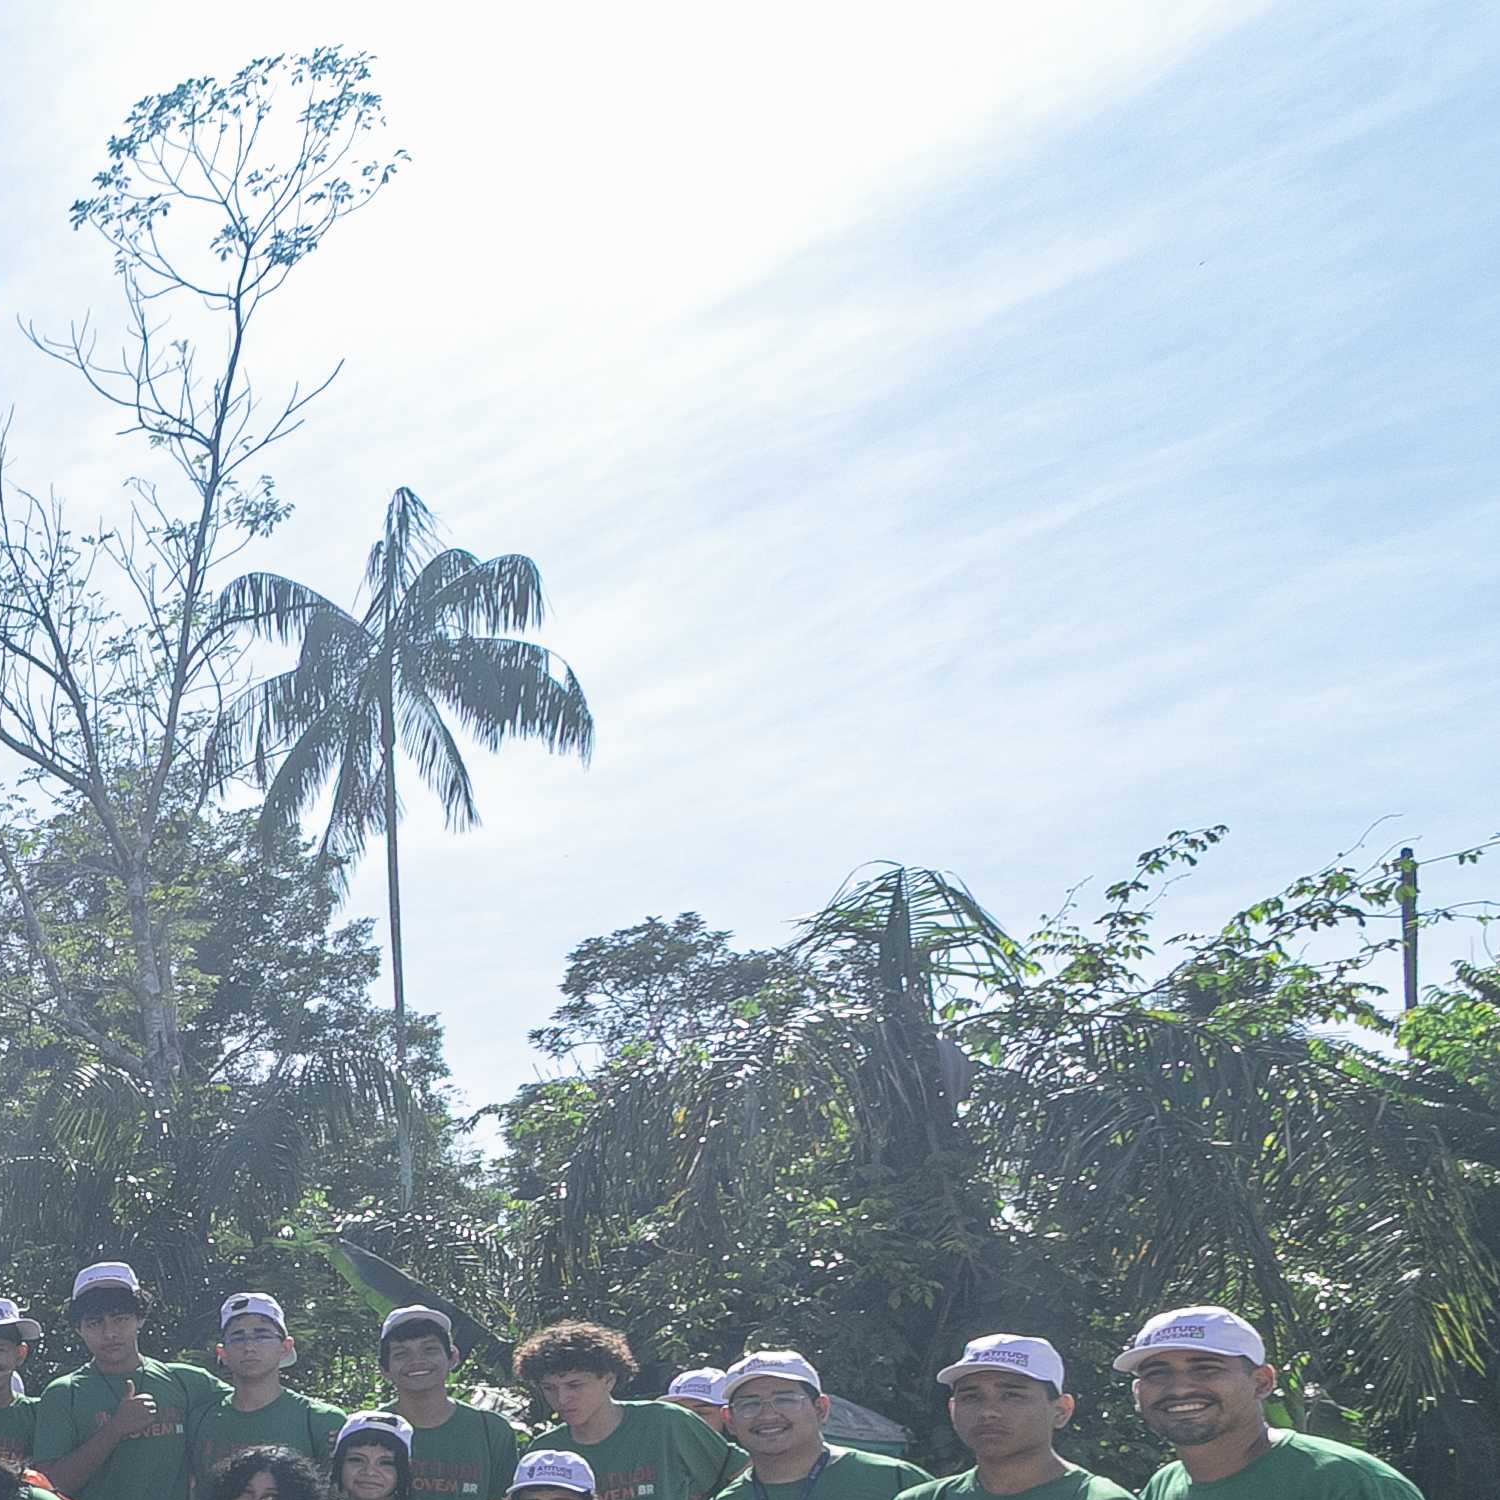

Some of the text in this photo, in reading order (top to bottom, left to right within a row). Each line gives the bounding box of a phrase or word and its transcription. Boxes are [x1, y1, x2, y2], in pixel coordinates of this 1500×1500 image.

[1154, 1325, 1206, 1337] ATITUDE
[983, 1351, 1029, 1362] ATITUDE
[461, 1482, 478, 1494] BR
[638, 1484, 655, 1496] BR
